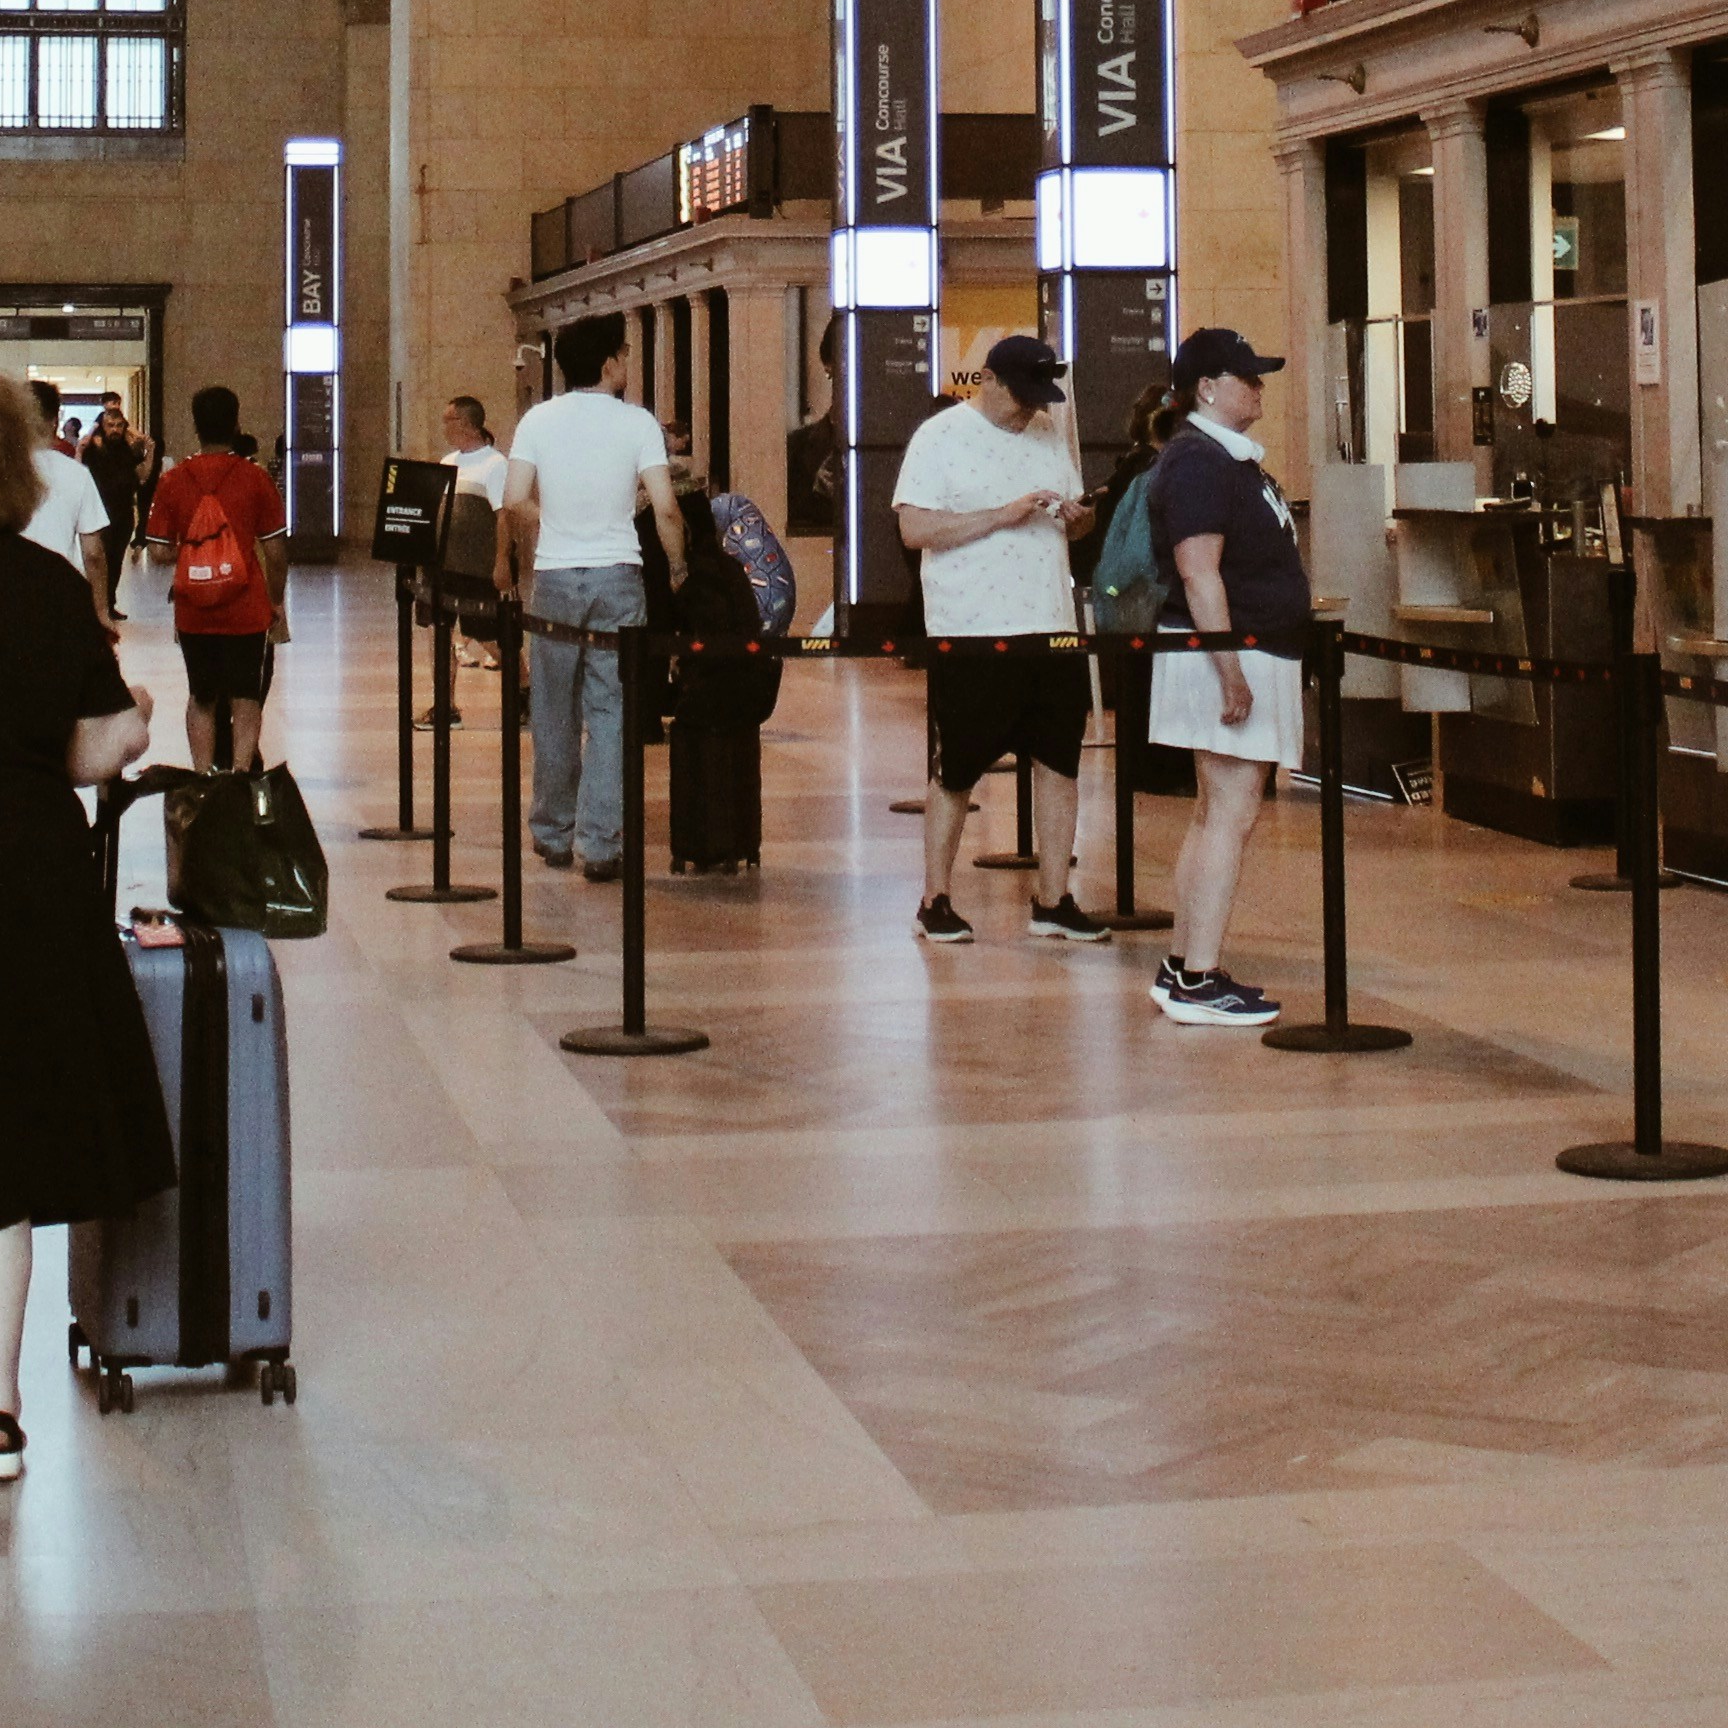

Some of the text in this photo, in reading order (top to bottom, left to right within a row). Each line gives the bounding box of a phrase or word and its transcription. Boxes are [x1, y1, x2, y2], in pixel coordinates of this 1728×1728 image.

[1119, 3, 1135, 44] Hall
[1097, 50, 1137, 137] VIA
[875, 43, 908, 204] VIA Concourse
[893, 98, 907, 131] Hall
[302, 269, 321, 314] BAY
[386, 505, 423, 517] ENTRANCE
[801, 638, 831, 651] VIA
[1049, 636, 1079, 648] VIA
